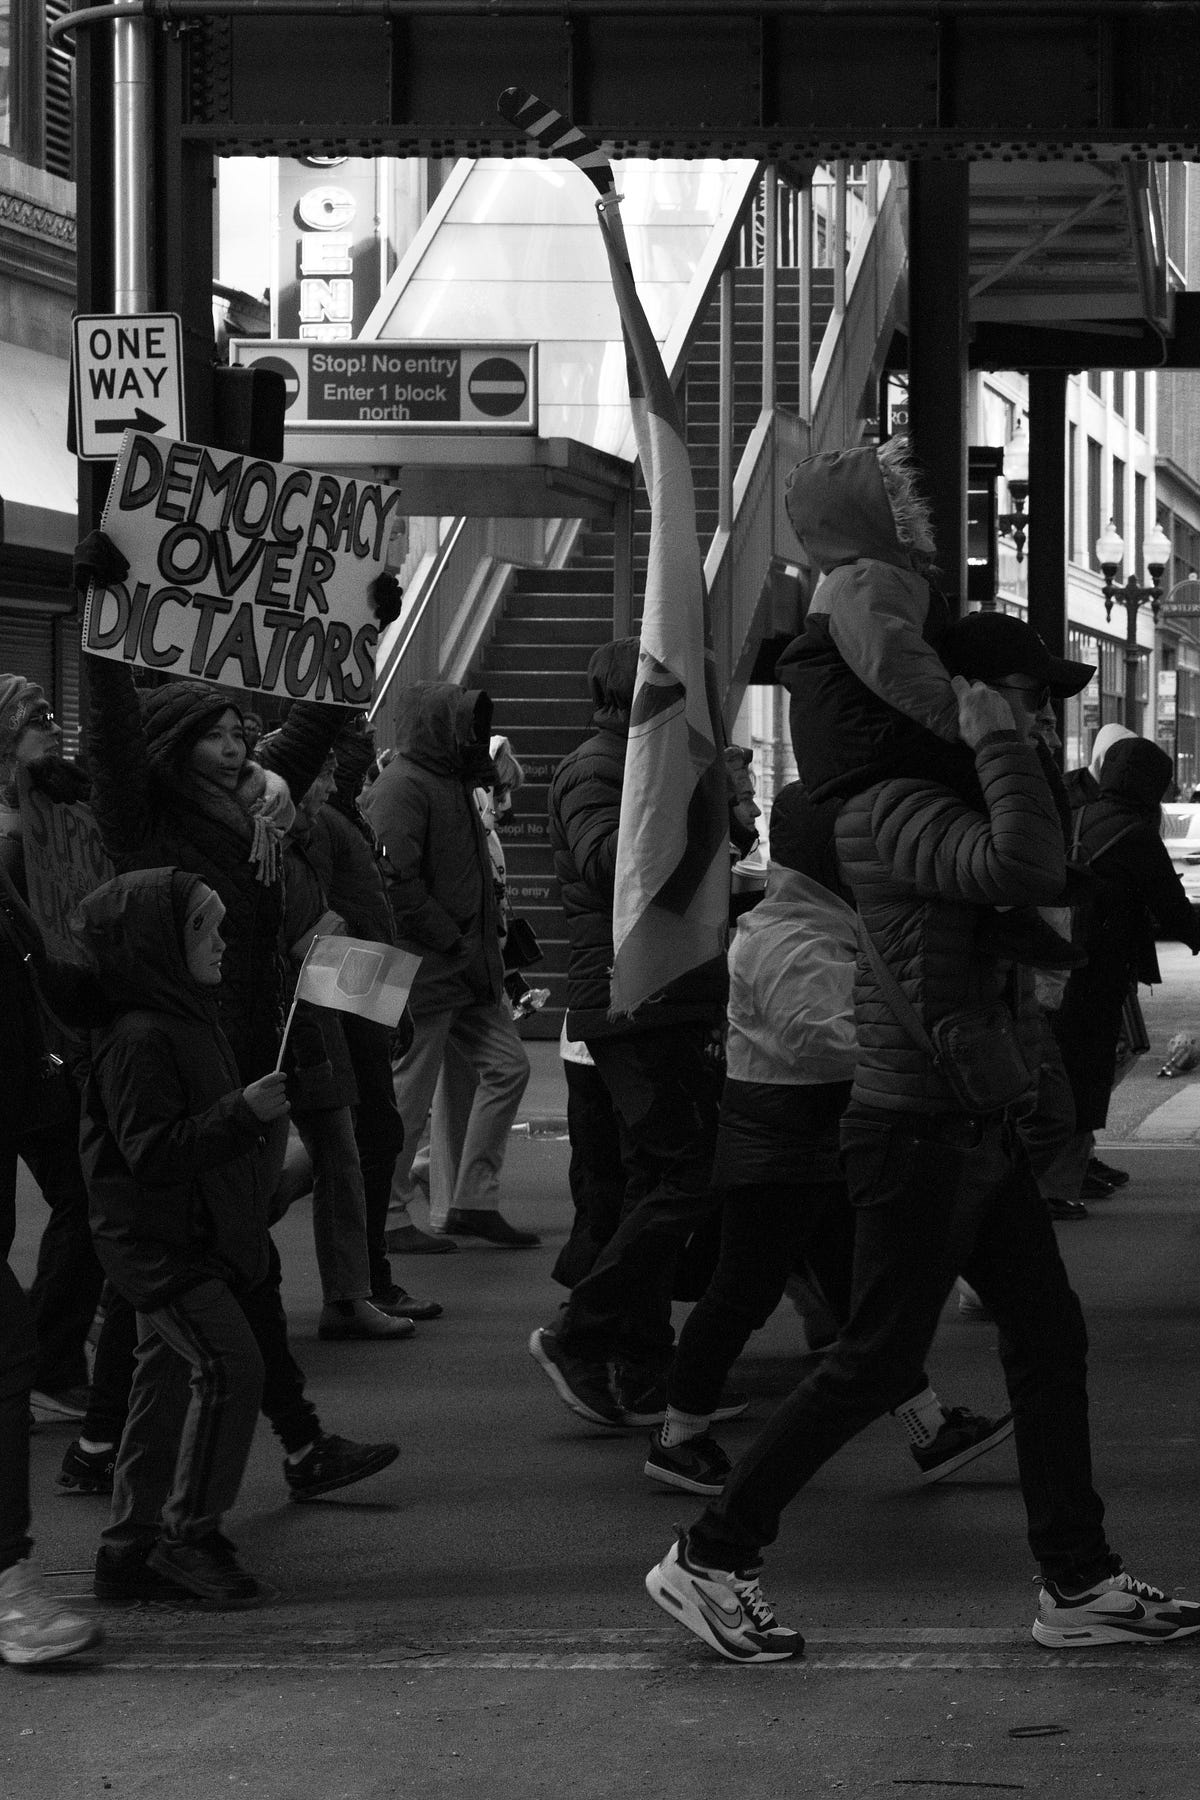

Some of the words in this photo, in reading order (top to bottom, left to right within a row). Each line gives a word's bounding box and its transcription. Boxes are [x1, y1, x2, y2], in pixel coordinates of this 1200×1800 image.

[89, 326, 167, 361] ONE
[311, 354, 367, 377] Stop!
[372, 355, 403, 373] No
[404, 356, 458, 377] entry
[88, 366, 169, 400] WAY
[323, 384, 374, 401] Enter
[379, 384, 388, 401] 1
[394, 383, 448, 401] block
[359, 405, 410, 420] north
[119, 434, 402, 562] DEMOCRACY
[157, 521, 336, 615] OVER
[86, 581, 378, 705] DICTATORS
